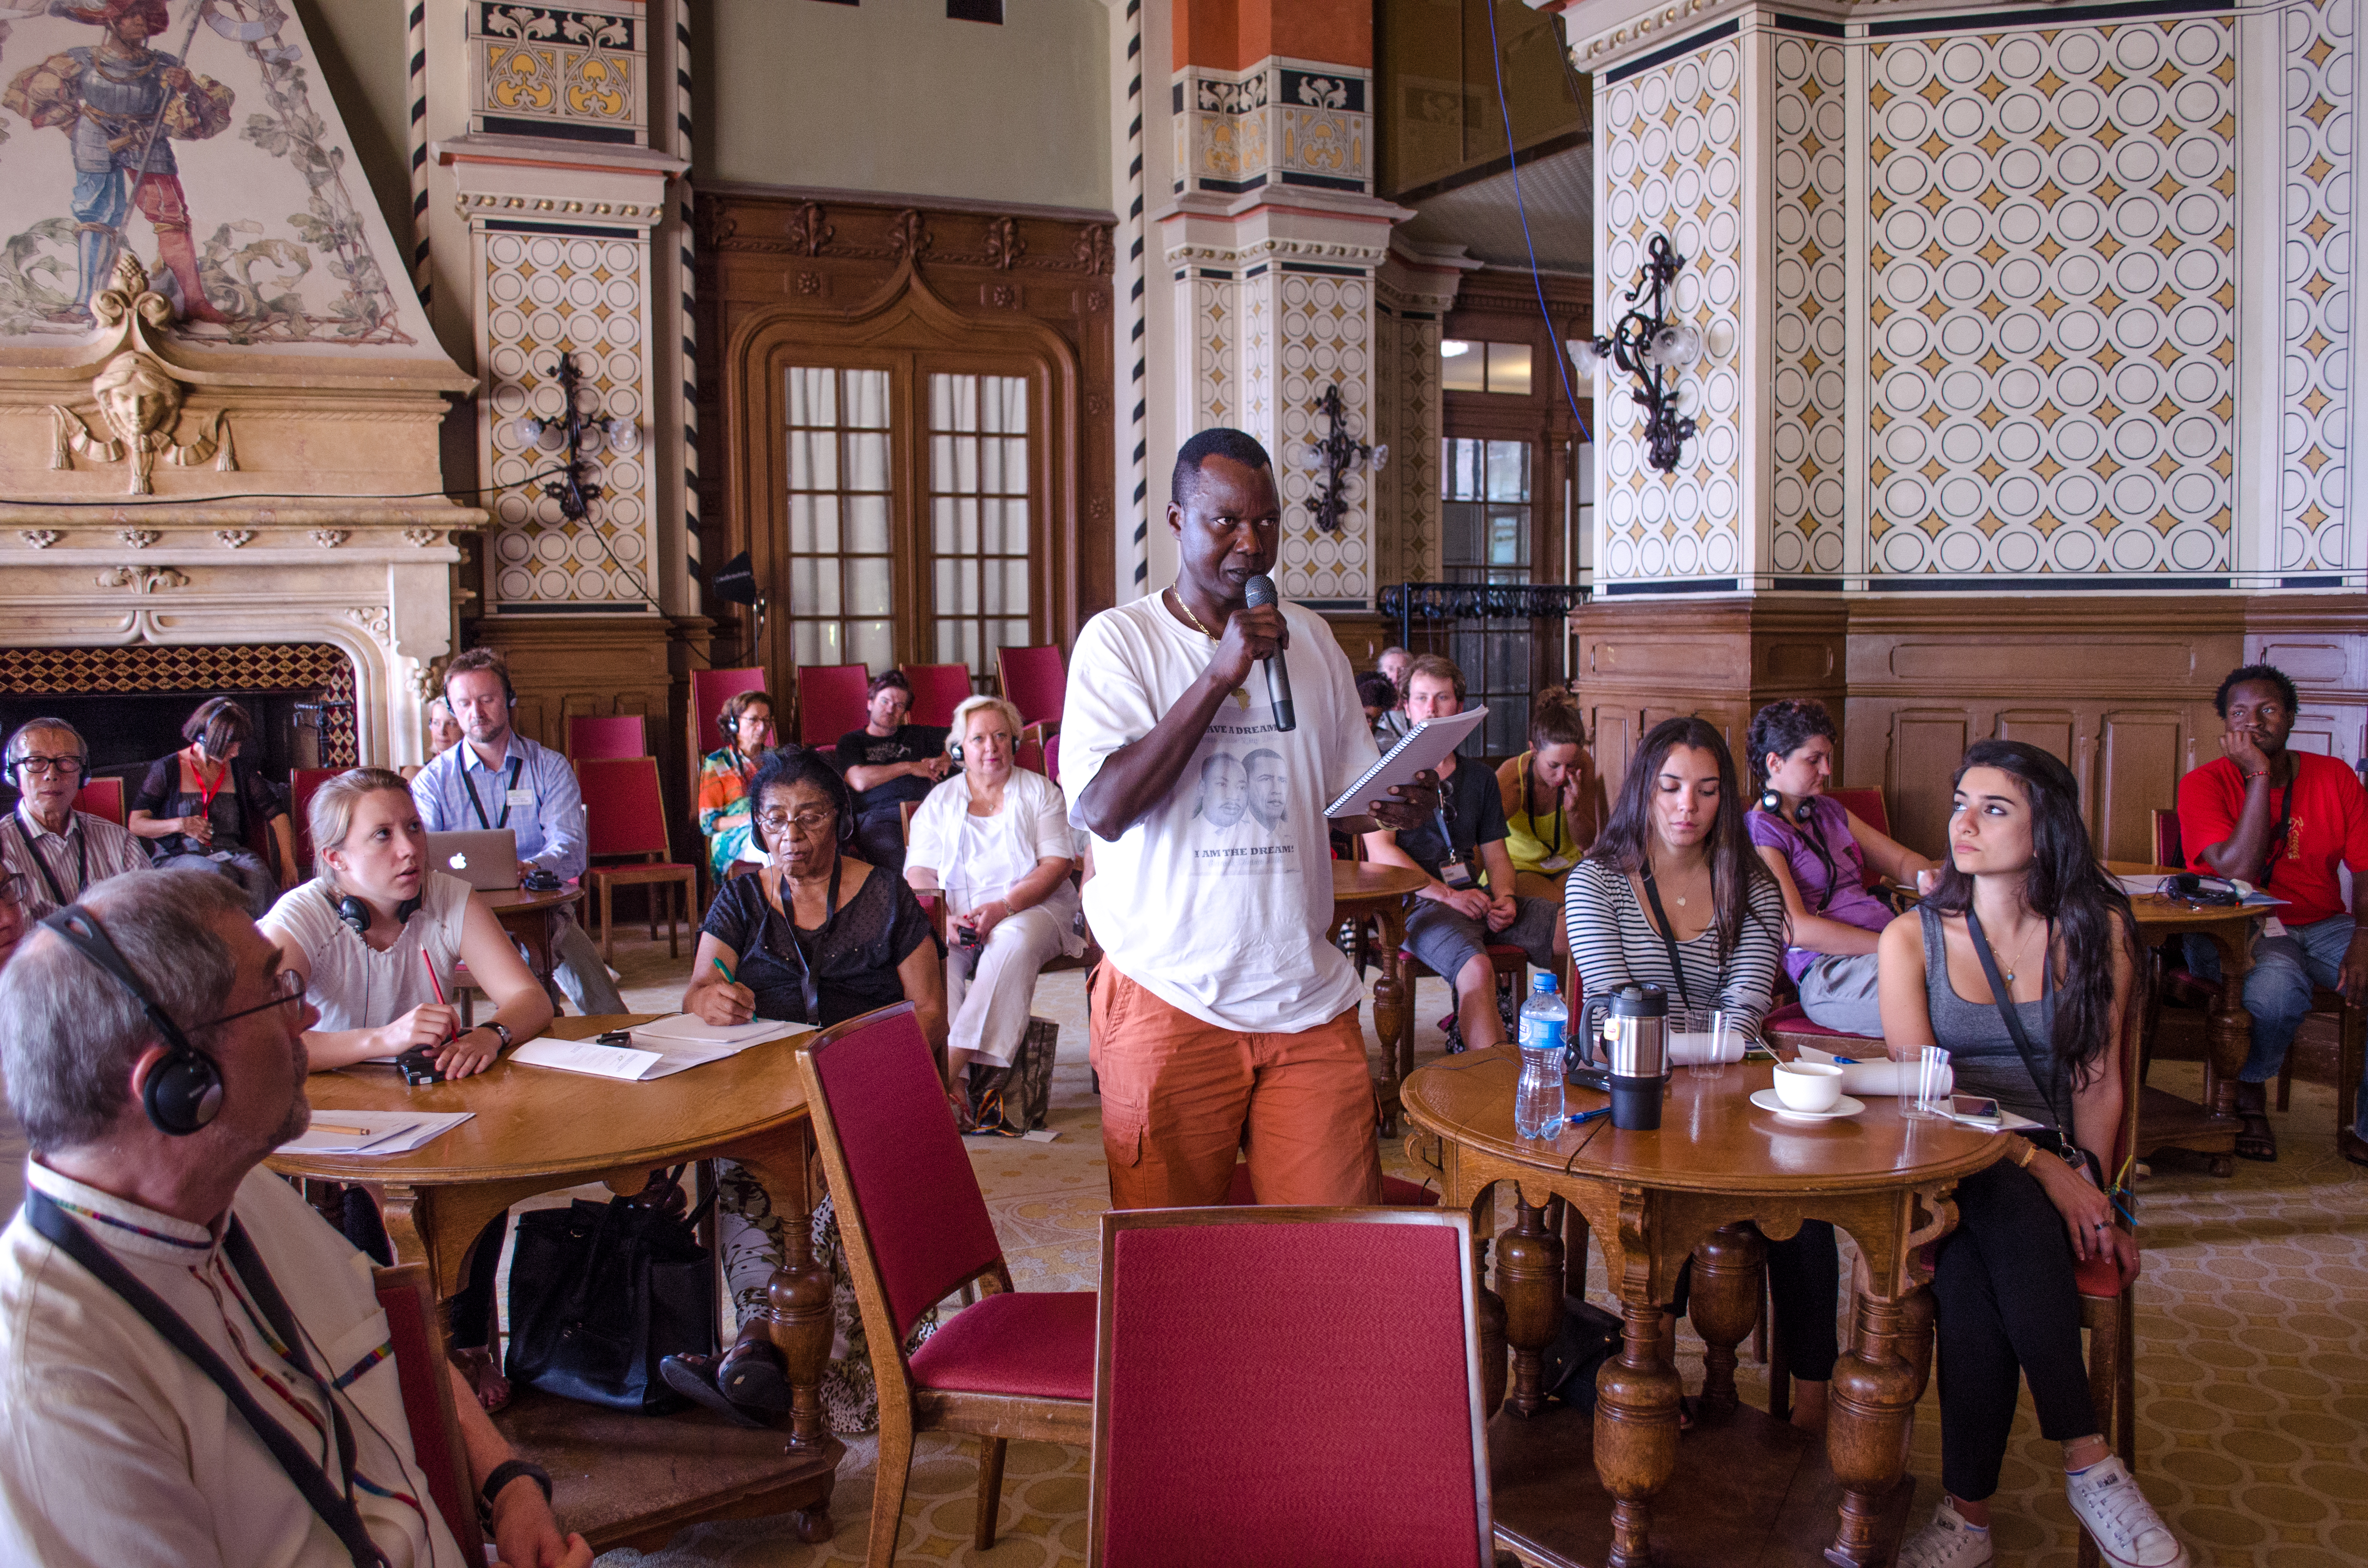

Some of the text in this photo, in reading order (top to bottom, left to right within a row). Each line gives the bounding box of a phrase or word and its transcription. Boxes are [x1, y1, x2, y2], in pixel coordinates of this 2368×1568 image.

[1206, 725, 1227, 734] AVE
[1229, 725, 1234, 735] A
[1194, 845, 1294, 858] I AM THE DREAM!
